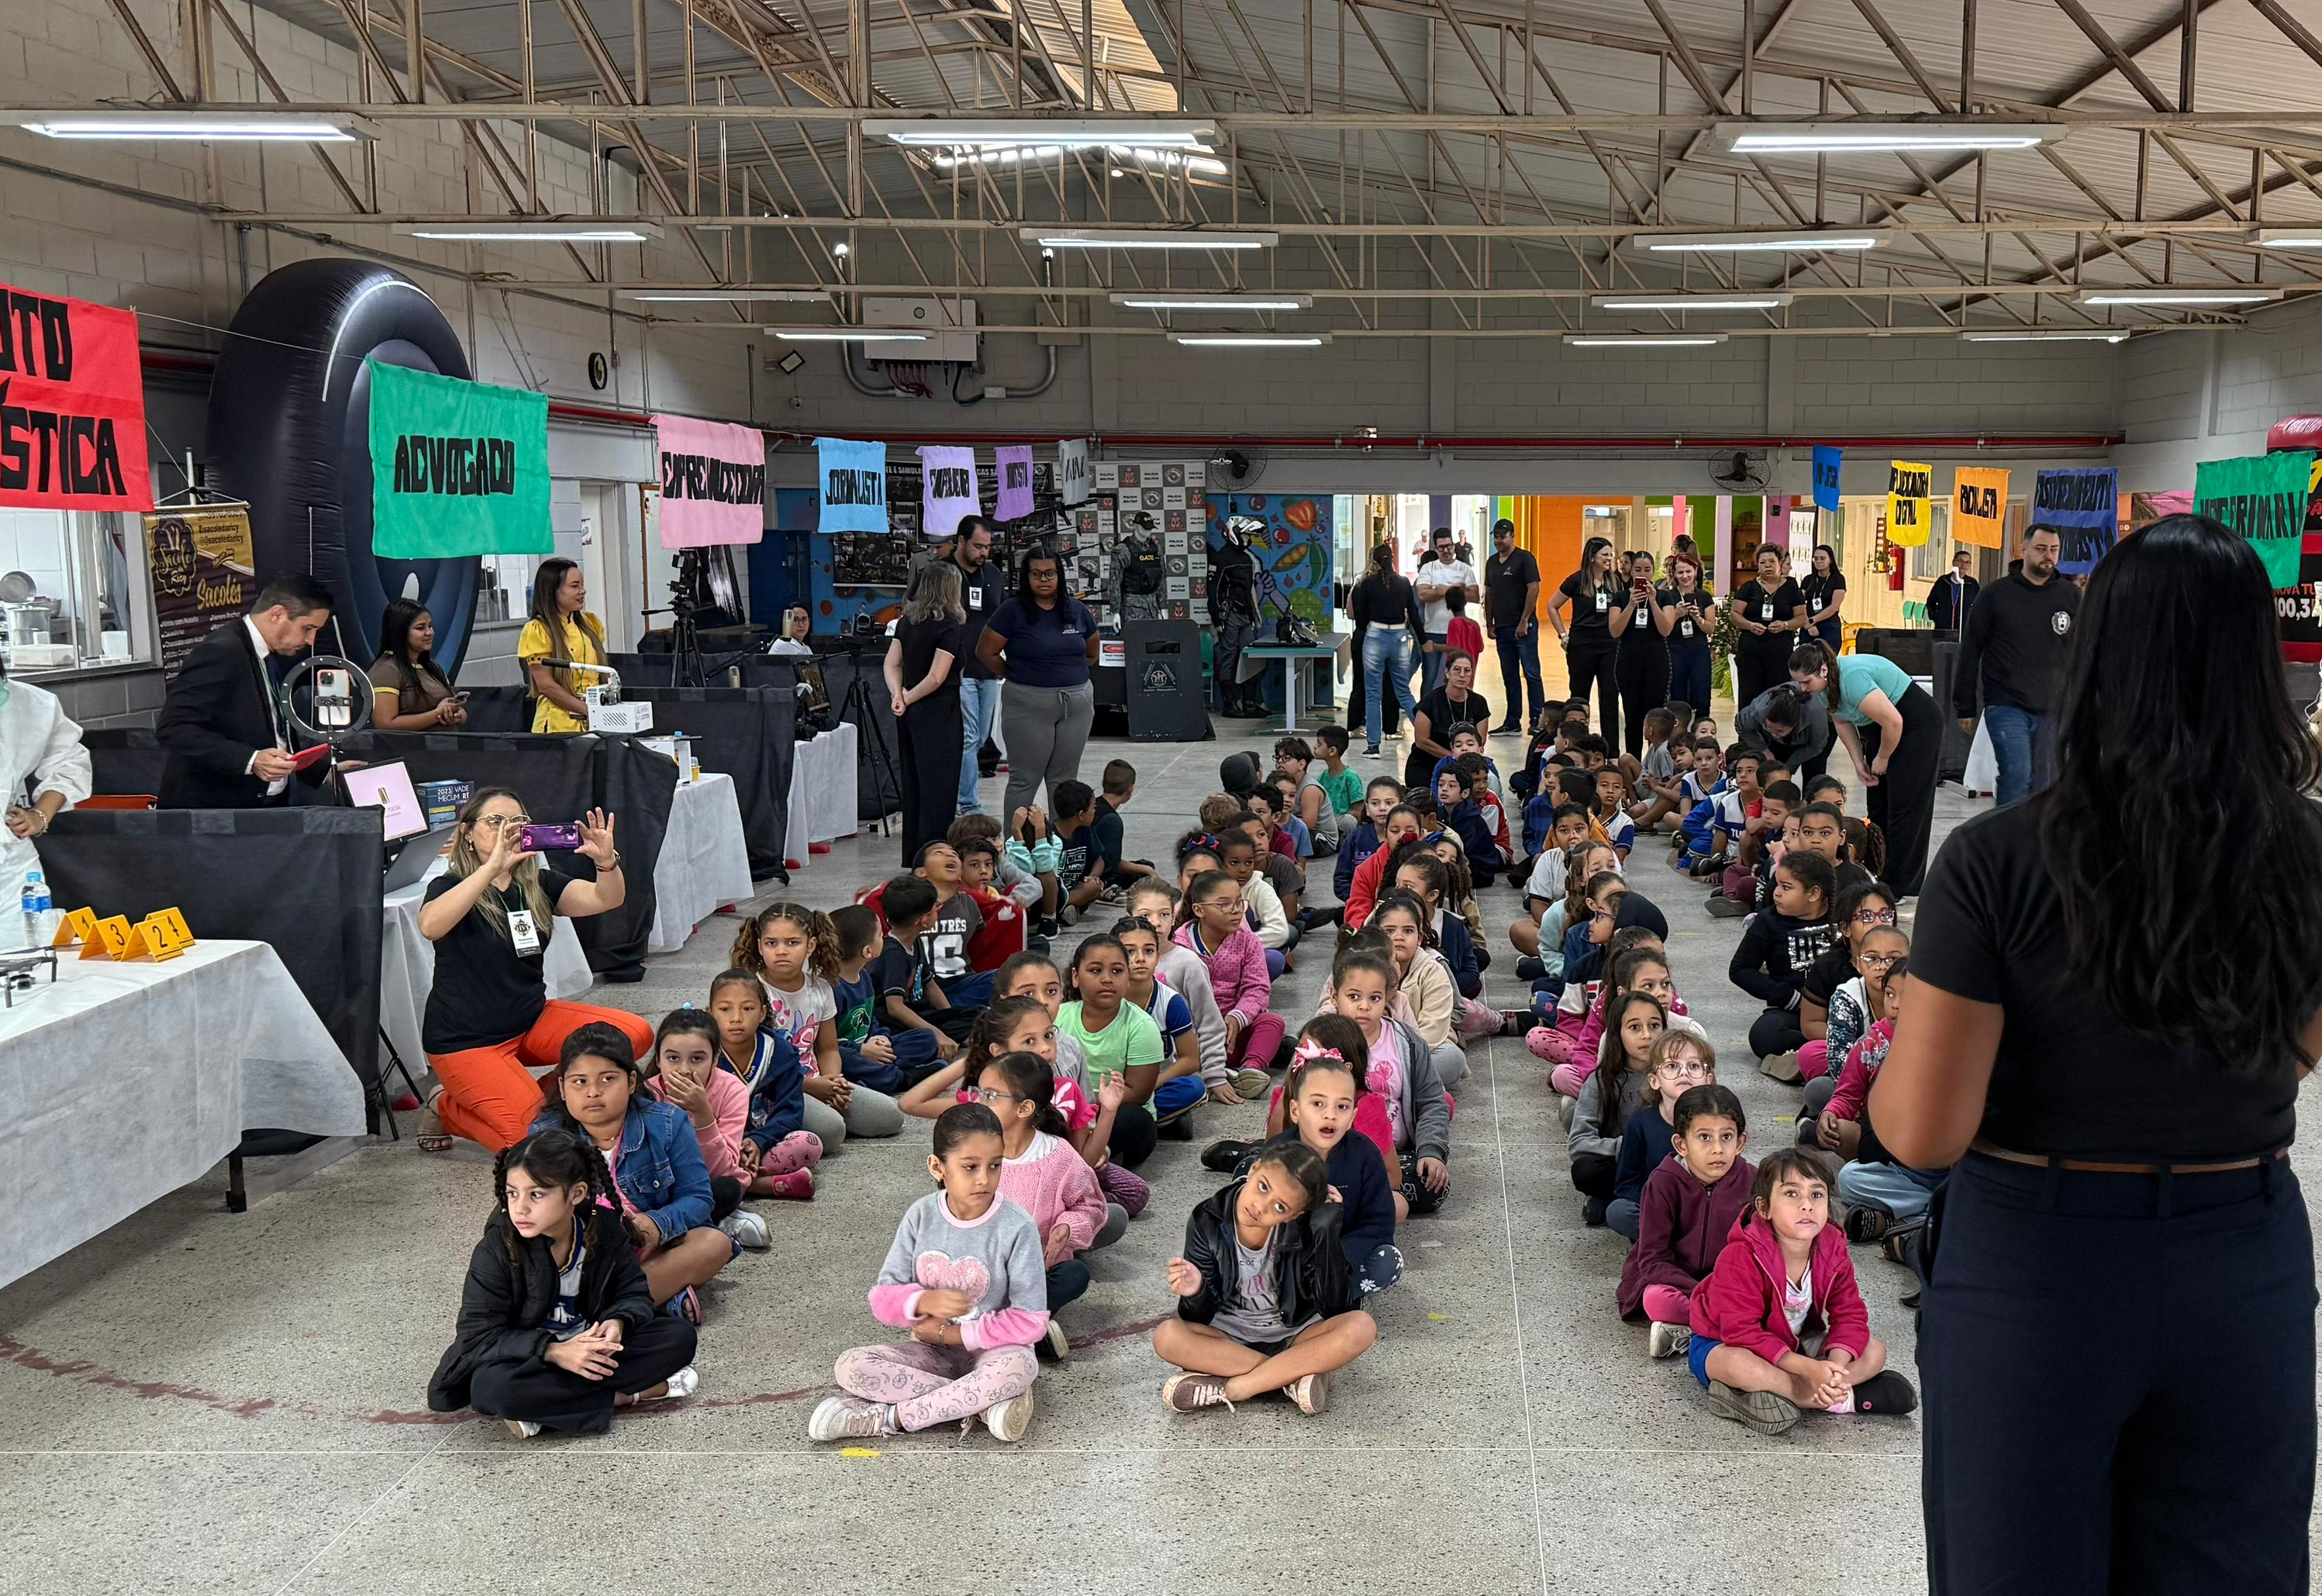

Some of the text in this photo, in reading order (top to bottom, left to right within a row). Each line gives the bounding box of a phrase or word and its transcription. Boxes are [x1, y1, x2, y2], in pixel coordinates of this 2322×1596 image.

[0, 405, 129, 496] STICA
[394, 435, 515, 496] ADVOGADO
[438, 793, 460, 802] MECUM
[110, 924, 125, 946] 3
[940, 917, 967, 932] TRÊS
[153, 926, 167, 948] 2
